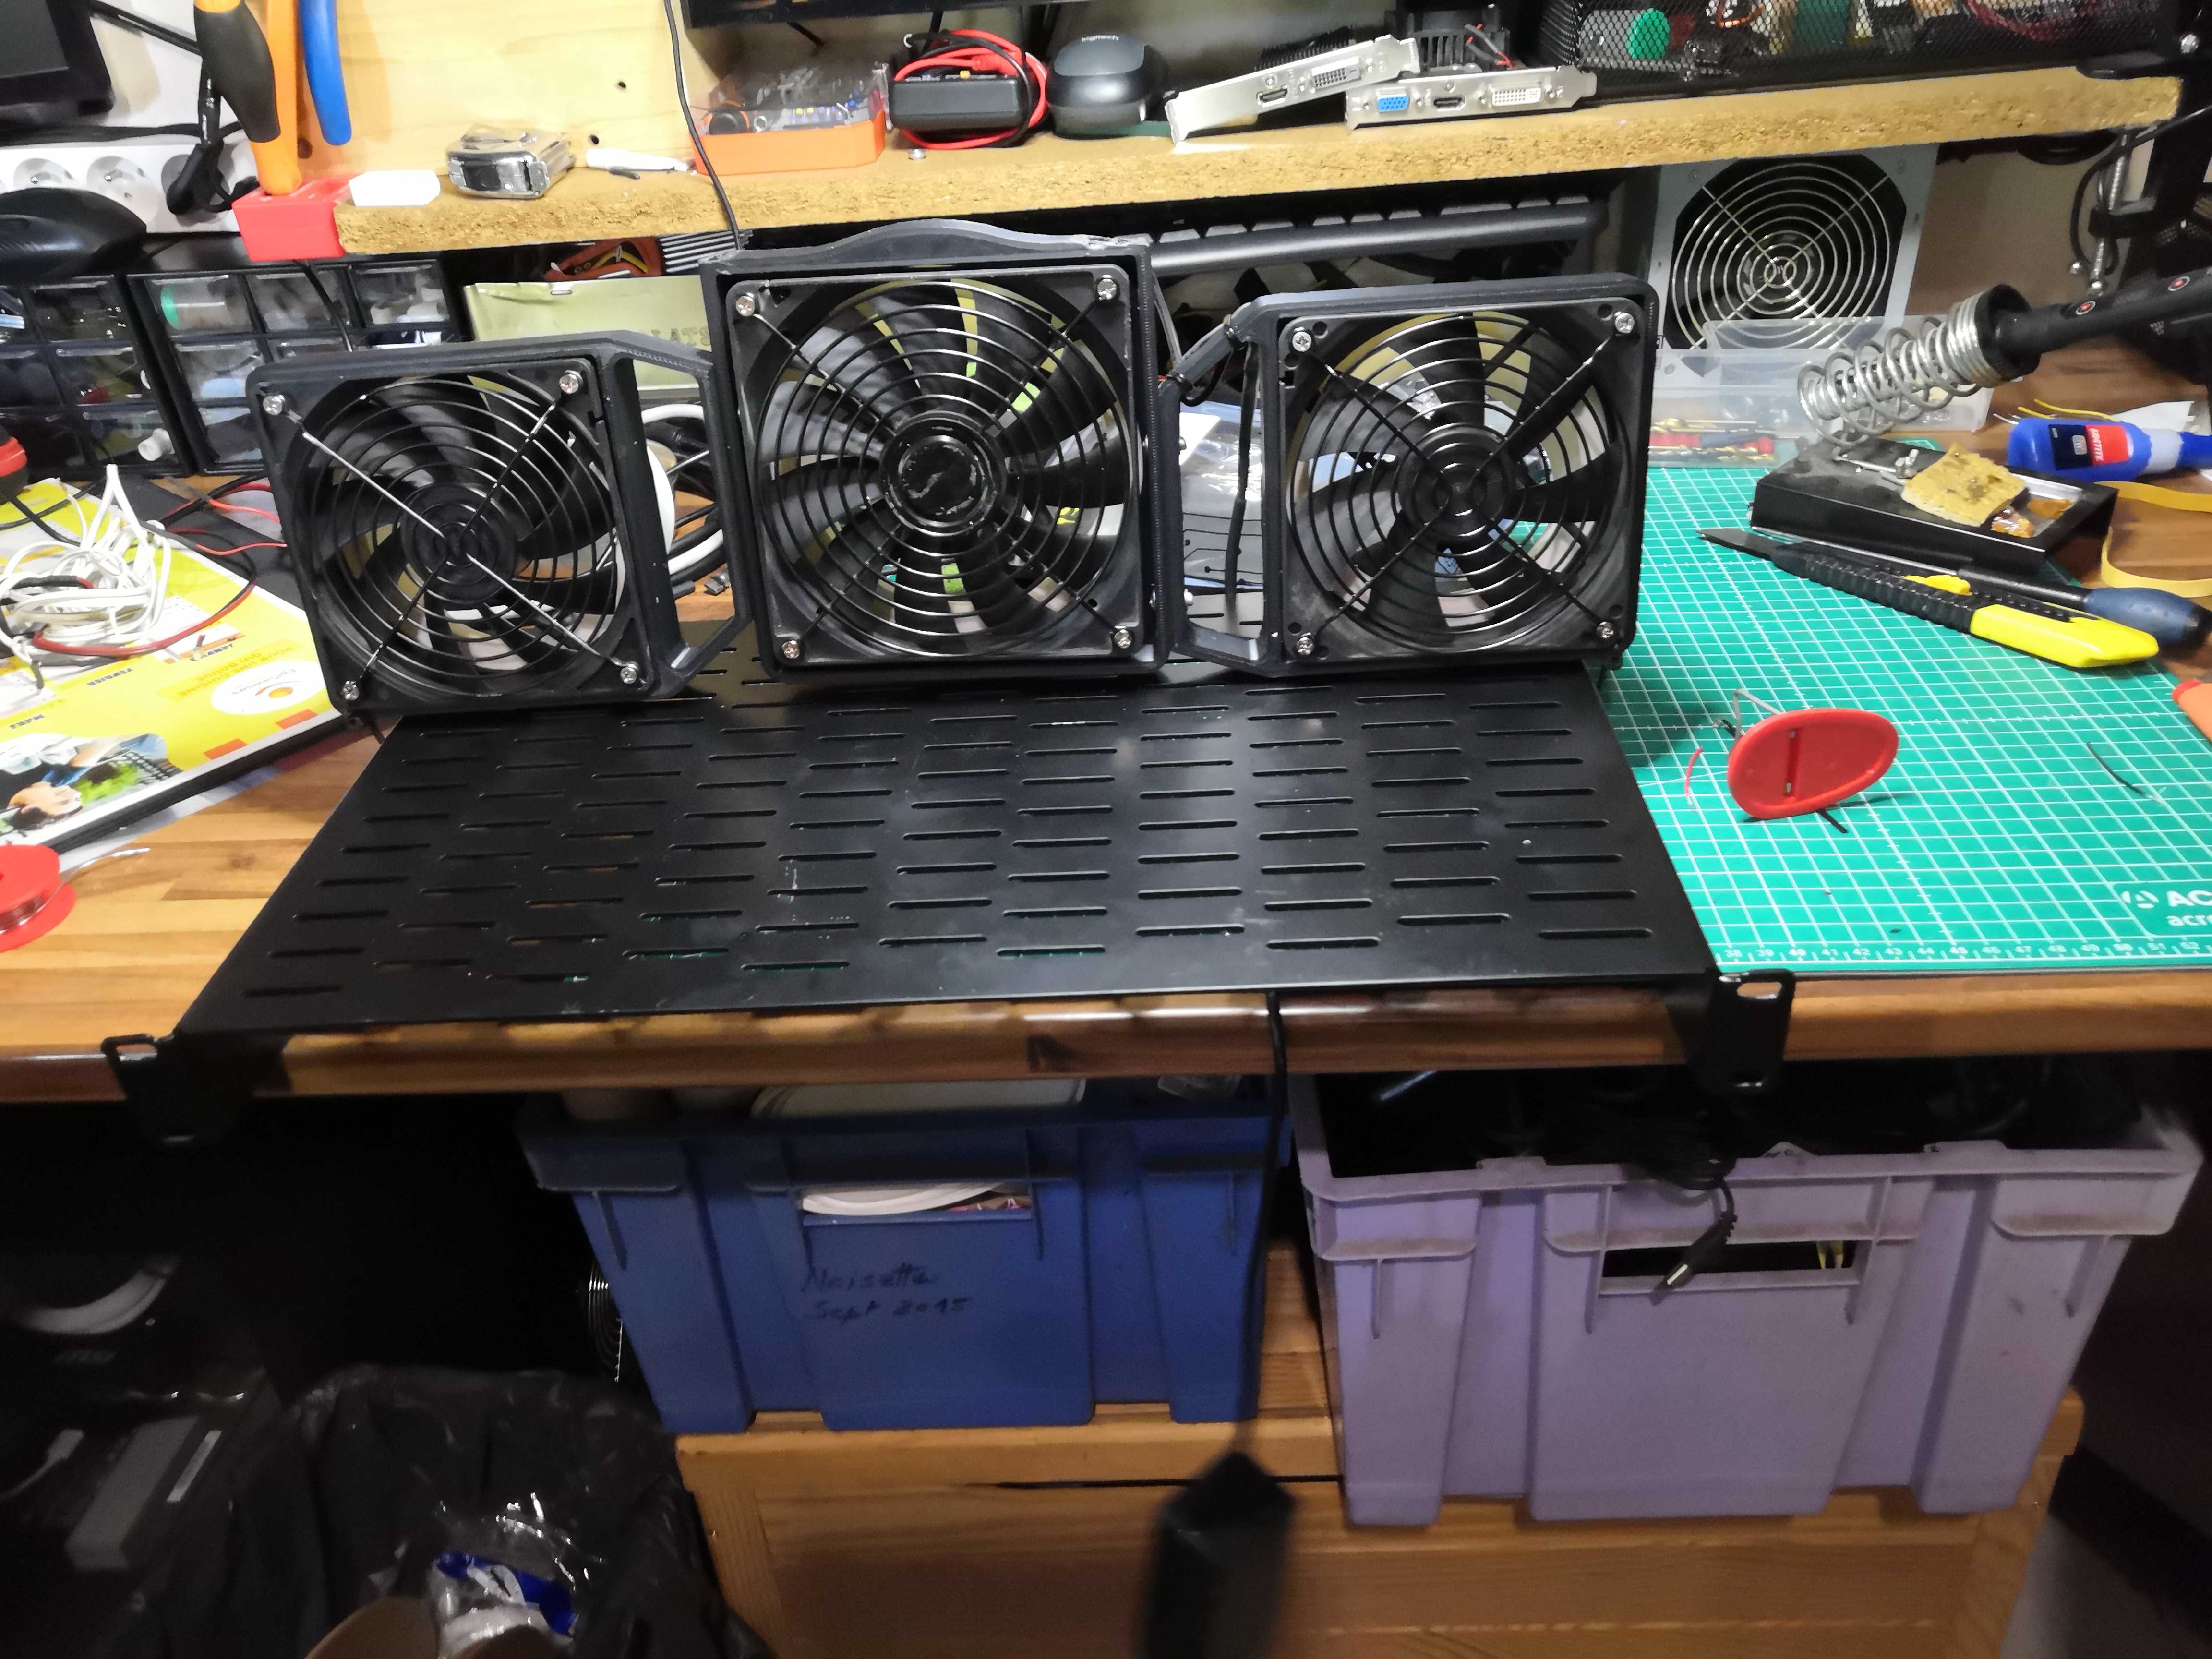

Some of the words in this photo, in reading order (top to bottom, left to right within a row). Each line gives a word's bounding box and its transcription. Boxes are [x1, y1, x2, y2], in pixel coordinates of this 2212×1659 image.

[2089, 428, 2104, 461] LOCTITE
[1789, 948, 1806, 956] 40
[1884, 947, 1903, 955] 43
[2147, 942, 2167, 950] 51
[2179, 941, 2200, 950] 52
